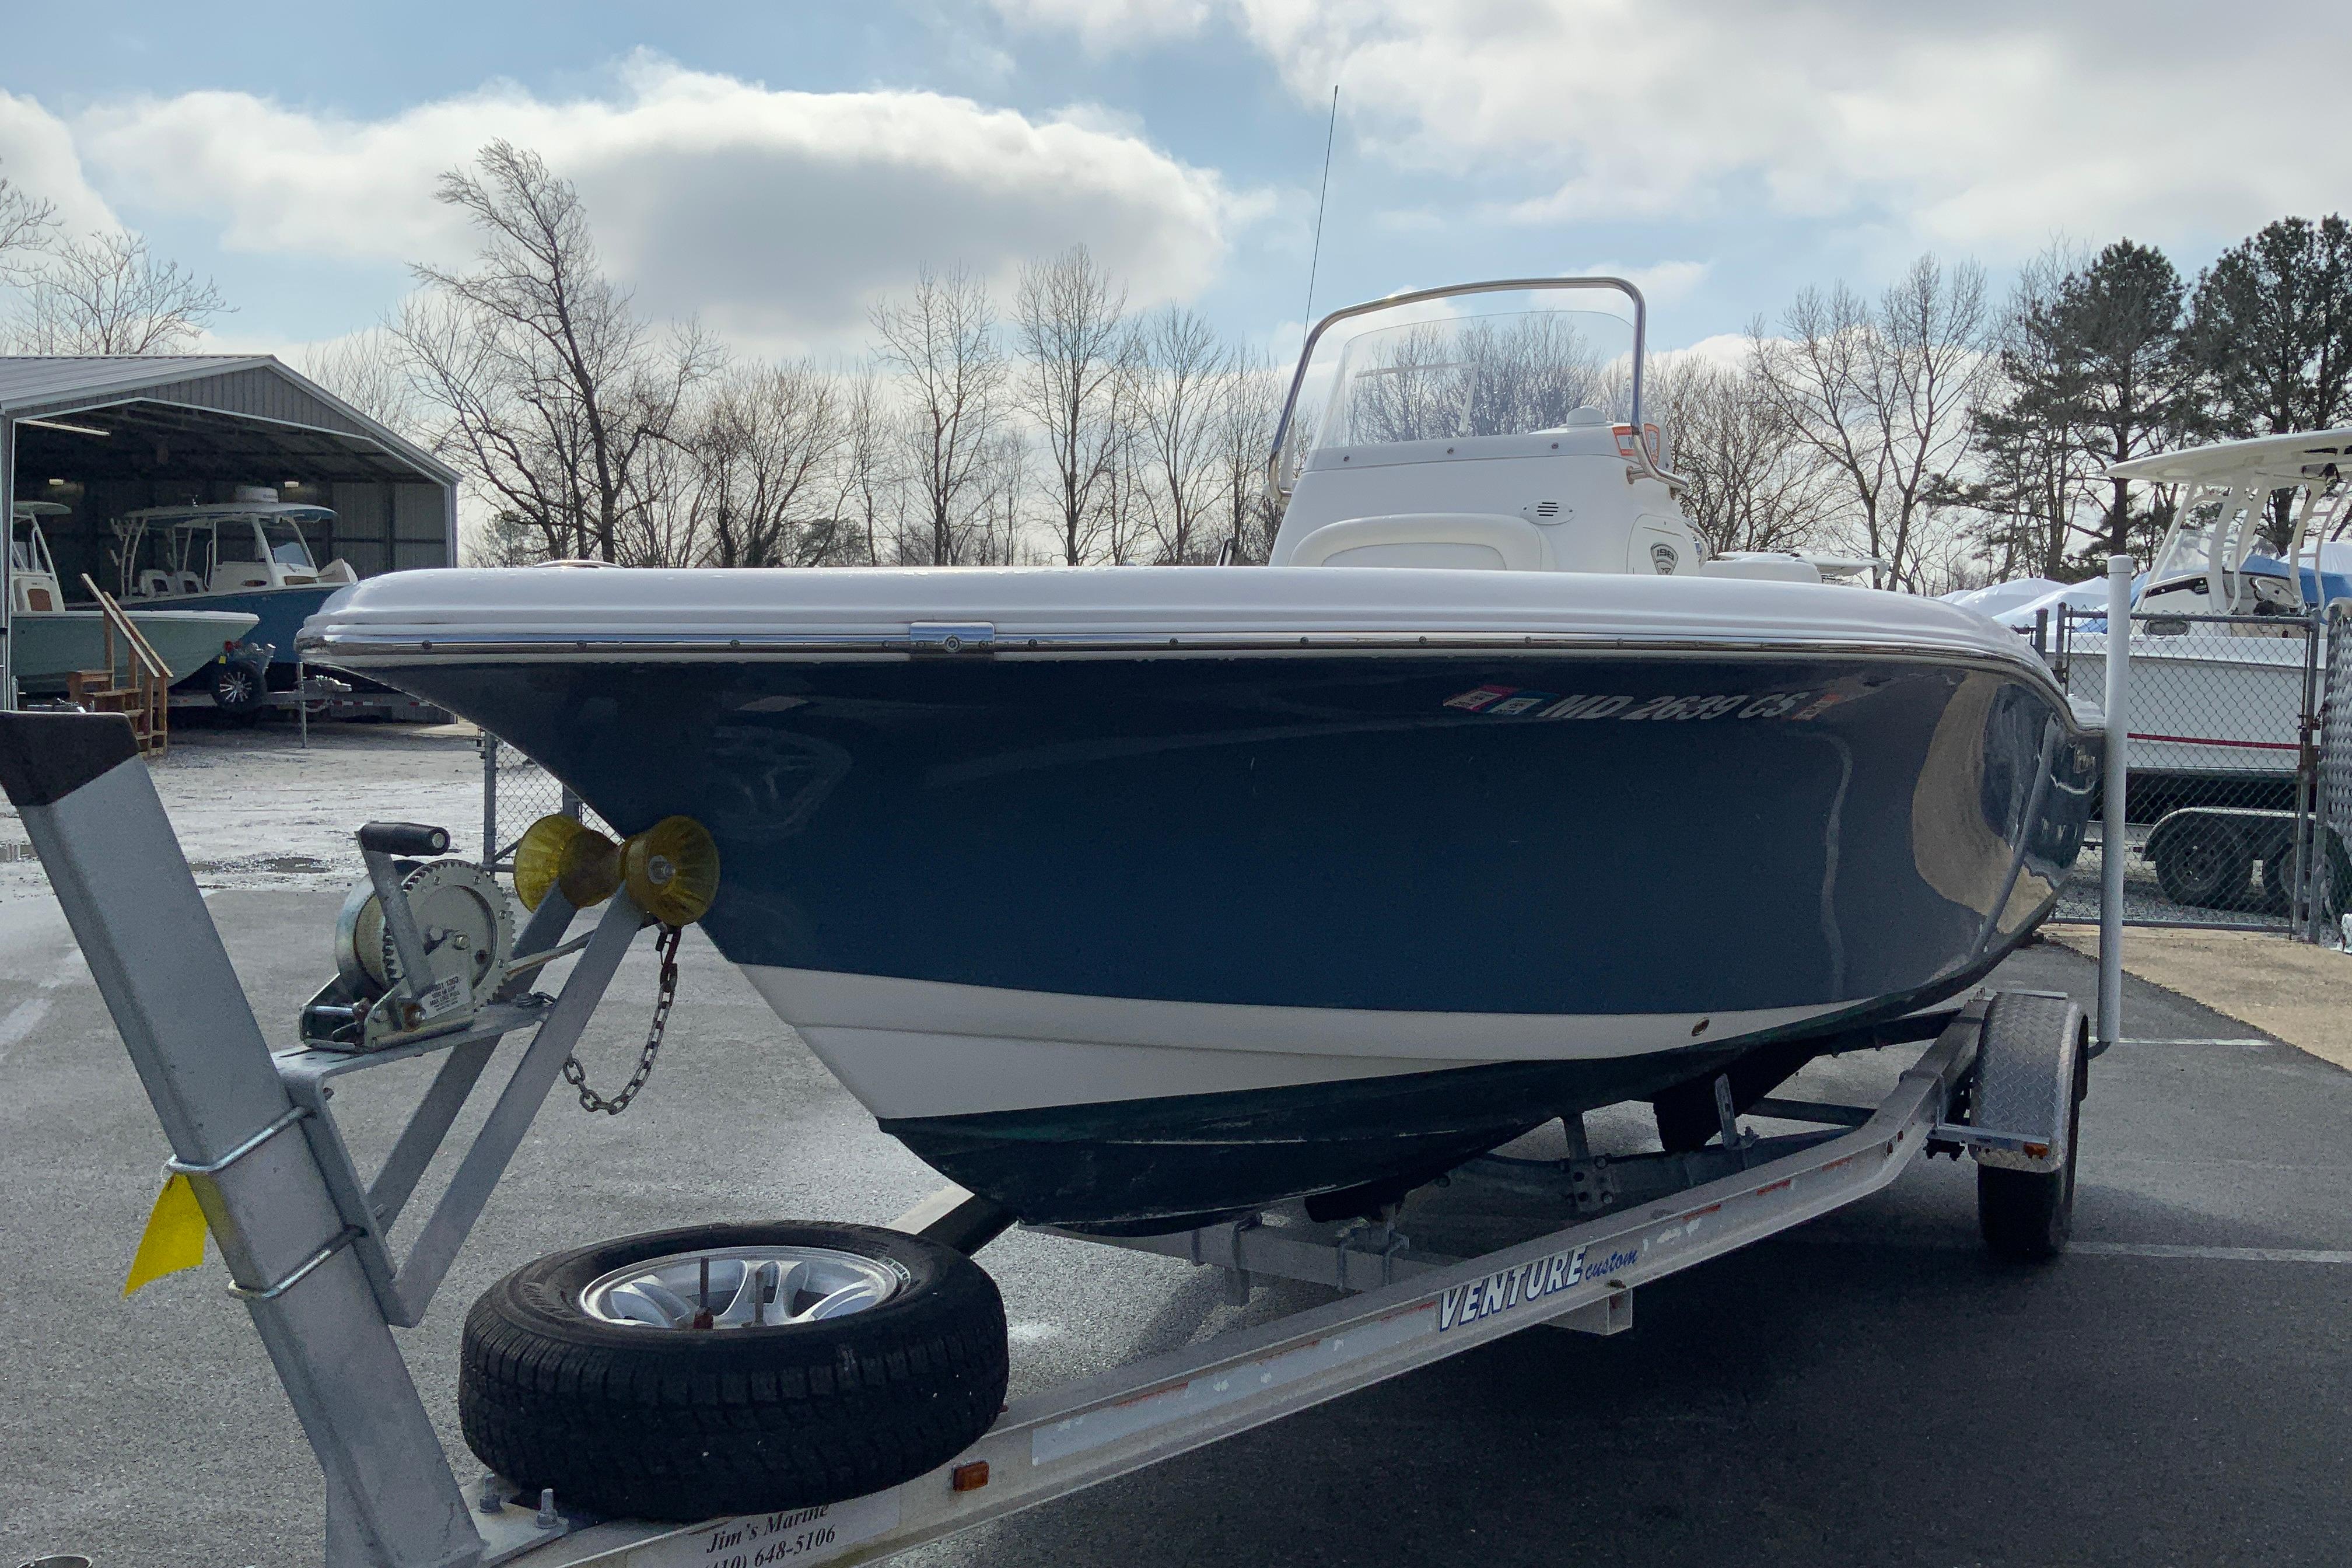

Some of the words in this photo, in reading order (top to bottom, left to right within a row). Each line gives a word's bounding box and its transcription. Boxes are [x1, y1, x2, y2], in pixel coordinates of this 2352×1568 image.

[1657, 548, 1674, 561] 198
[1536, 694, 1634, 719] MD
[1738, 692, 1810, 719] CS
[1439, 1245, 1588, 1332] VENTURE
[1585, 1250, 1638, 1281] custom
[763, 1504, 830, 1536] Marine
[754, 1523, 836, 1567] 648-5106
